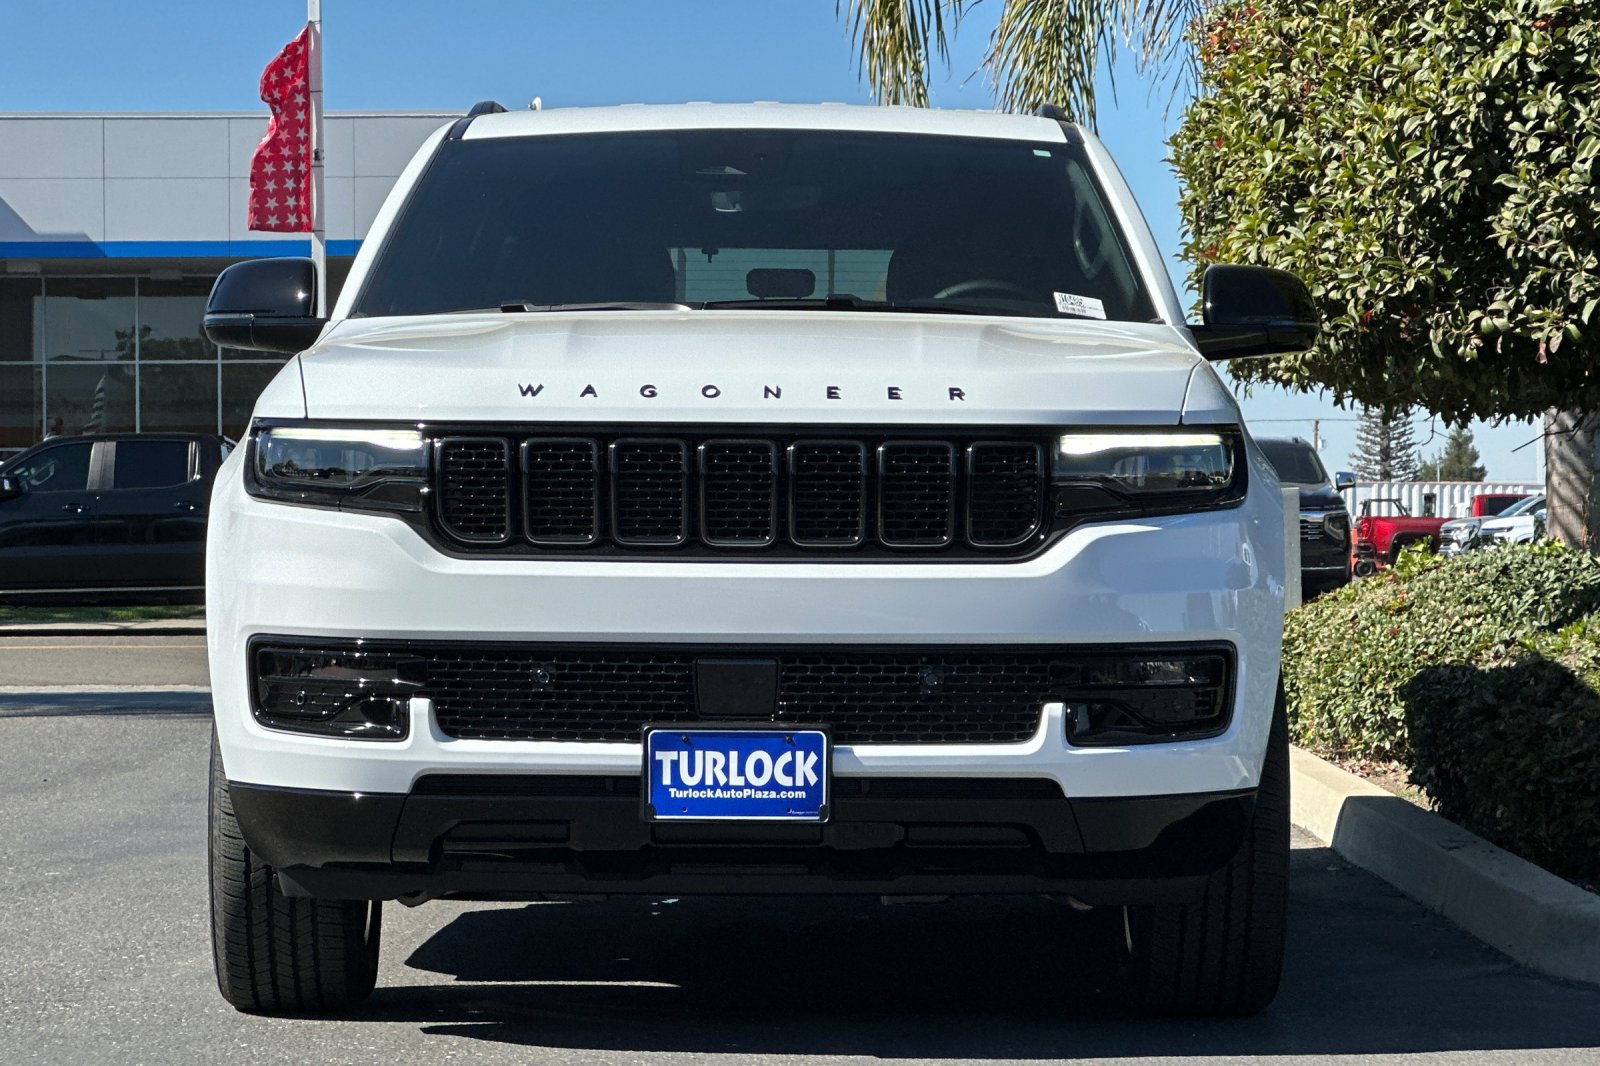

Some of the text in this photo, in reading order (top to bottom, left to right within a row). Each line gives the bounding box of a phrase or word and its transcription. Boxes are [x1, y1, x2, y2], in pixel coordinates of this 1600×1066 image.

[518, 383, 966, 401] WAGONEER
[655, 749, 819, 787] TURLOCK
[668, 788, 806, 799] TurlockAutoPlaza.com
